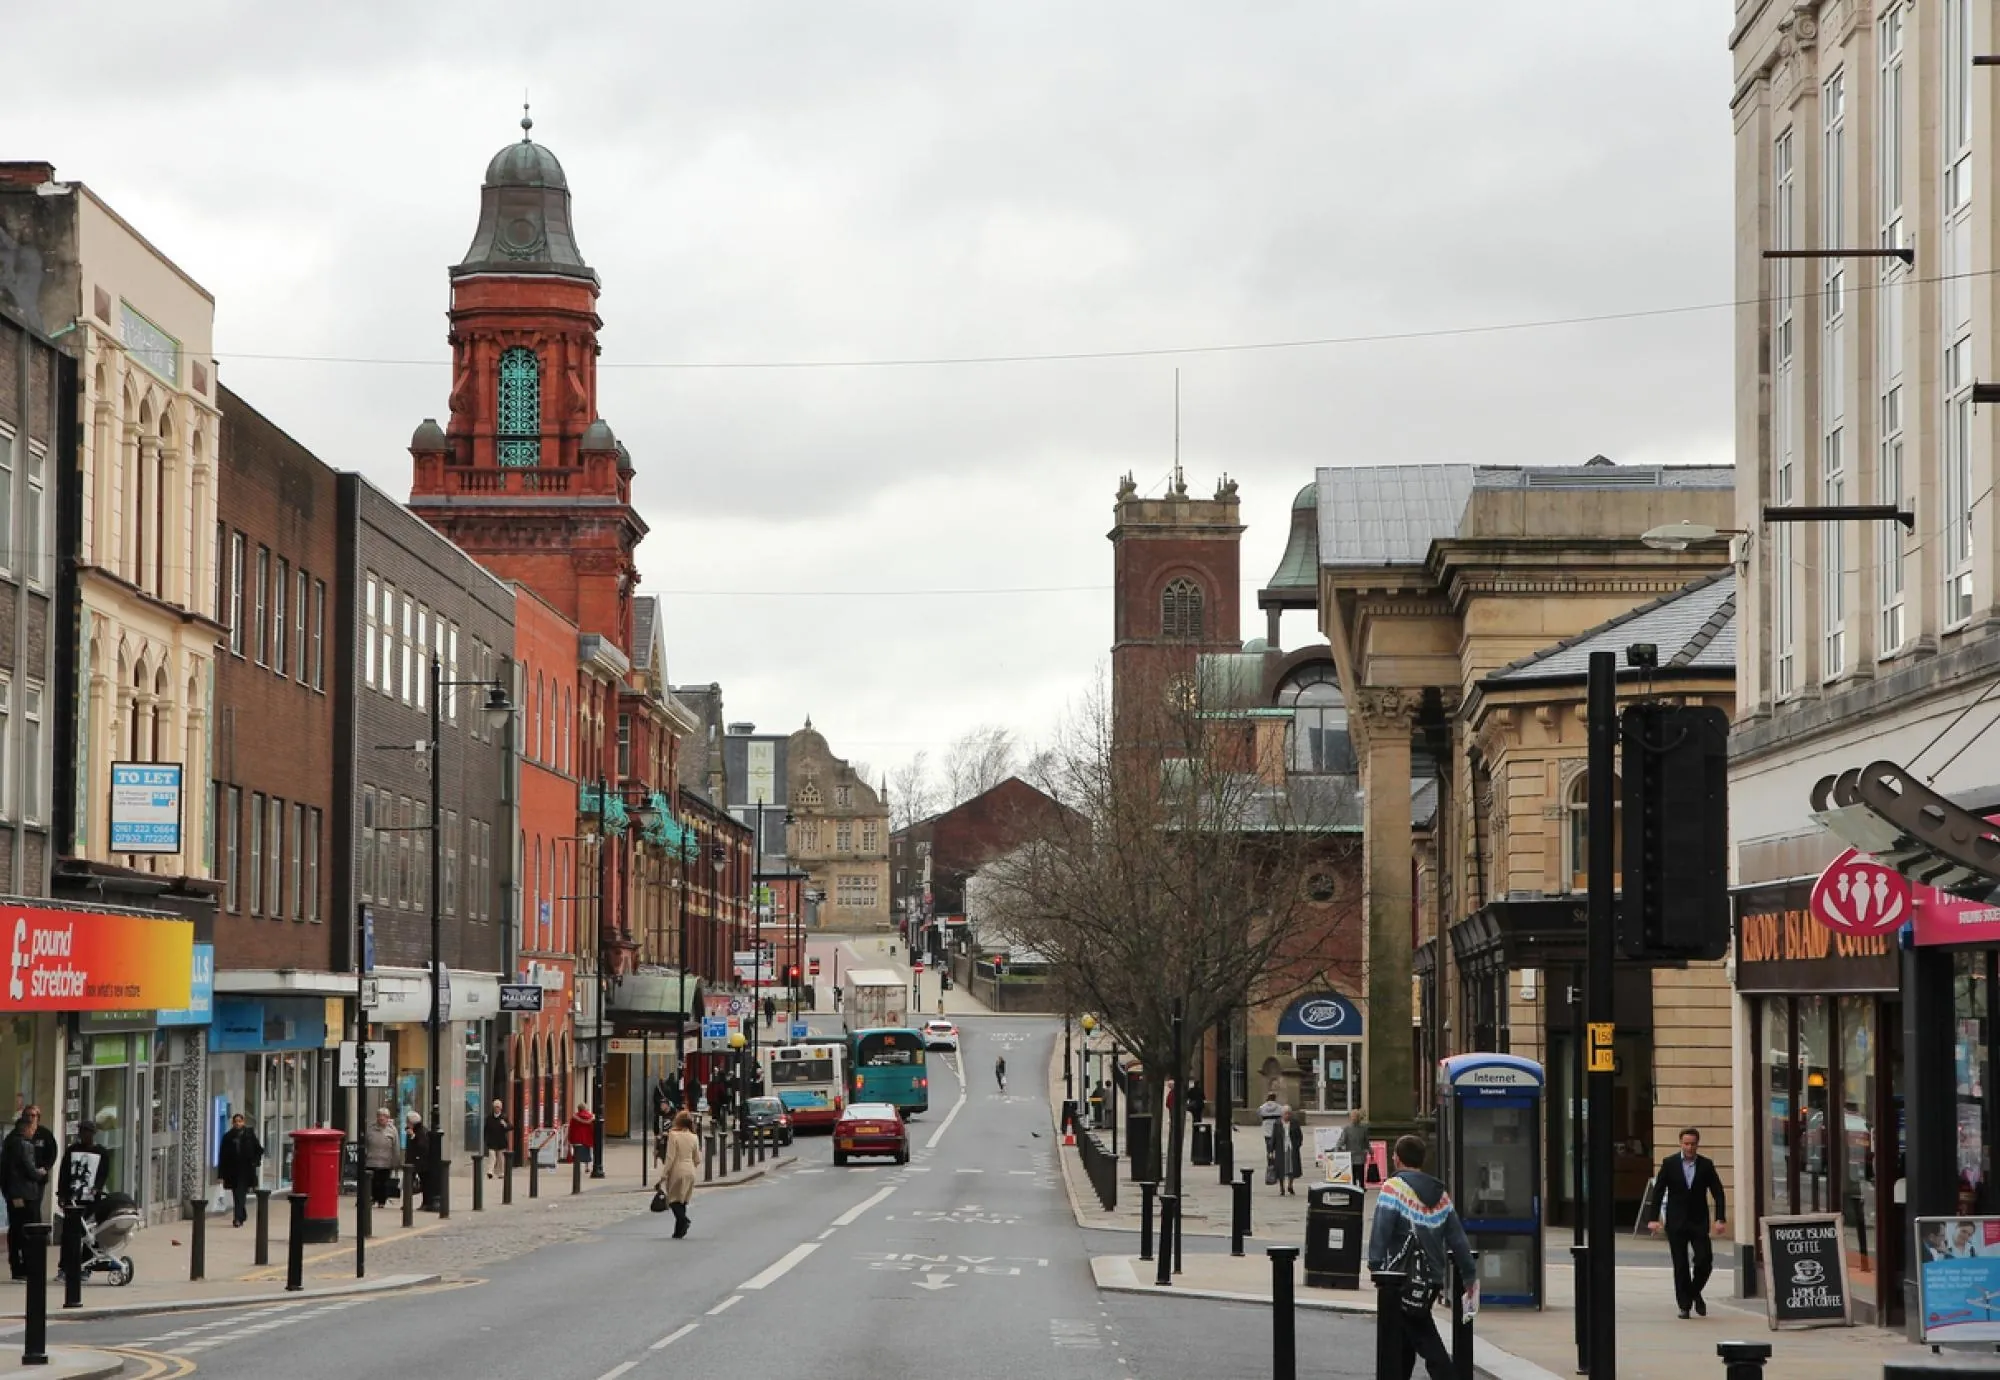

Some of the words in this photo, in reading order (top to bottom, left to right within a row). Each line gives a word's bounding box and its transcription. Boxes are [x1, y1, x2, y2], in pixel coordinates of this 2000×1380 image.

[117, 771, 140, 784] TO
[143, 772, 174, 784] LET
[1742, 912, 1779, 962] RHODE
[1784, 909, 1829, 961] ISLAND
[31, 923, 73, 964] pound
[31, 962, 88, 998] stretcher
[1305, 1005, 1337, 1023] Boots
[1474, 1073, 1516, 1082] Internet
[1775, 1229, 1804, 1241] RHODE
[1806, 1227, 1837, 1239] ISLAND
[1787, 1240, 1822, 1254] COFFEE
[1792, 1287, 1817, 1298] HOME
[1817, 1285, 1829, 1297] OF
[1786, 1297, 1814, 1308] GREAT
[1814, 1295, 1842, 1307] COFFEE
